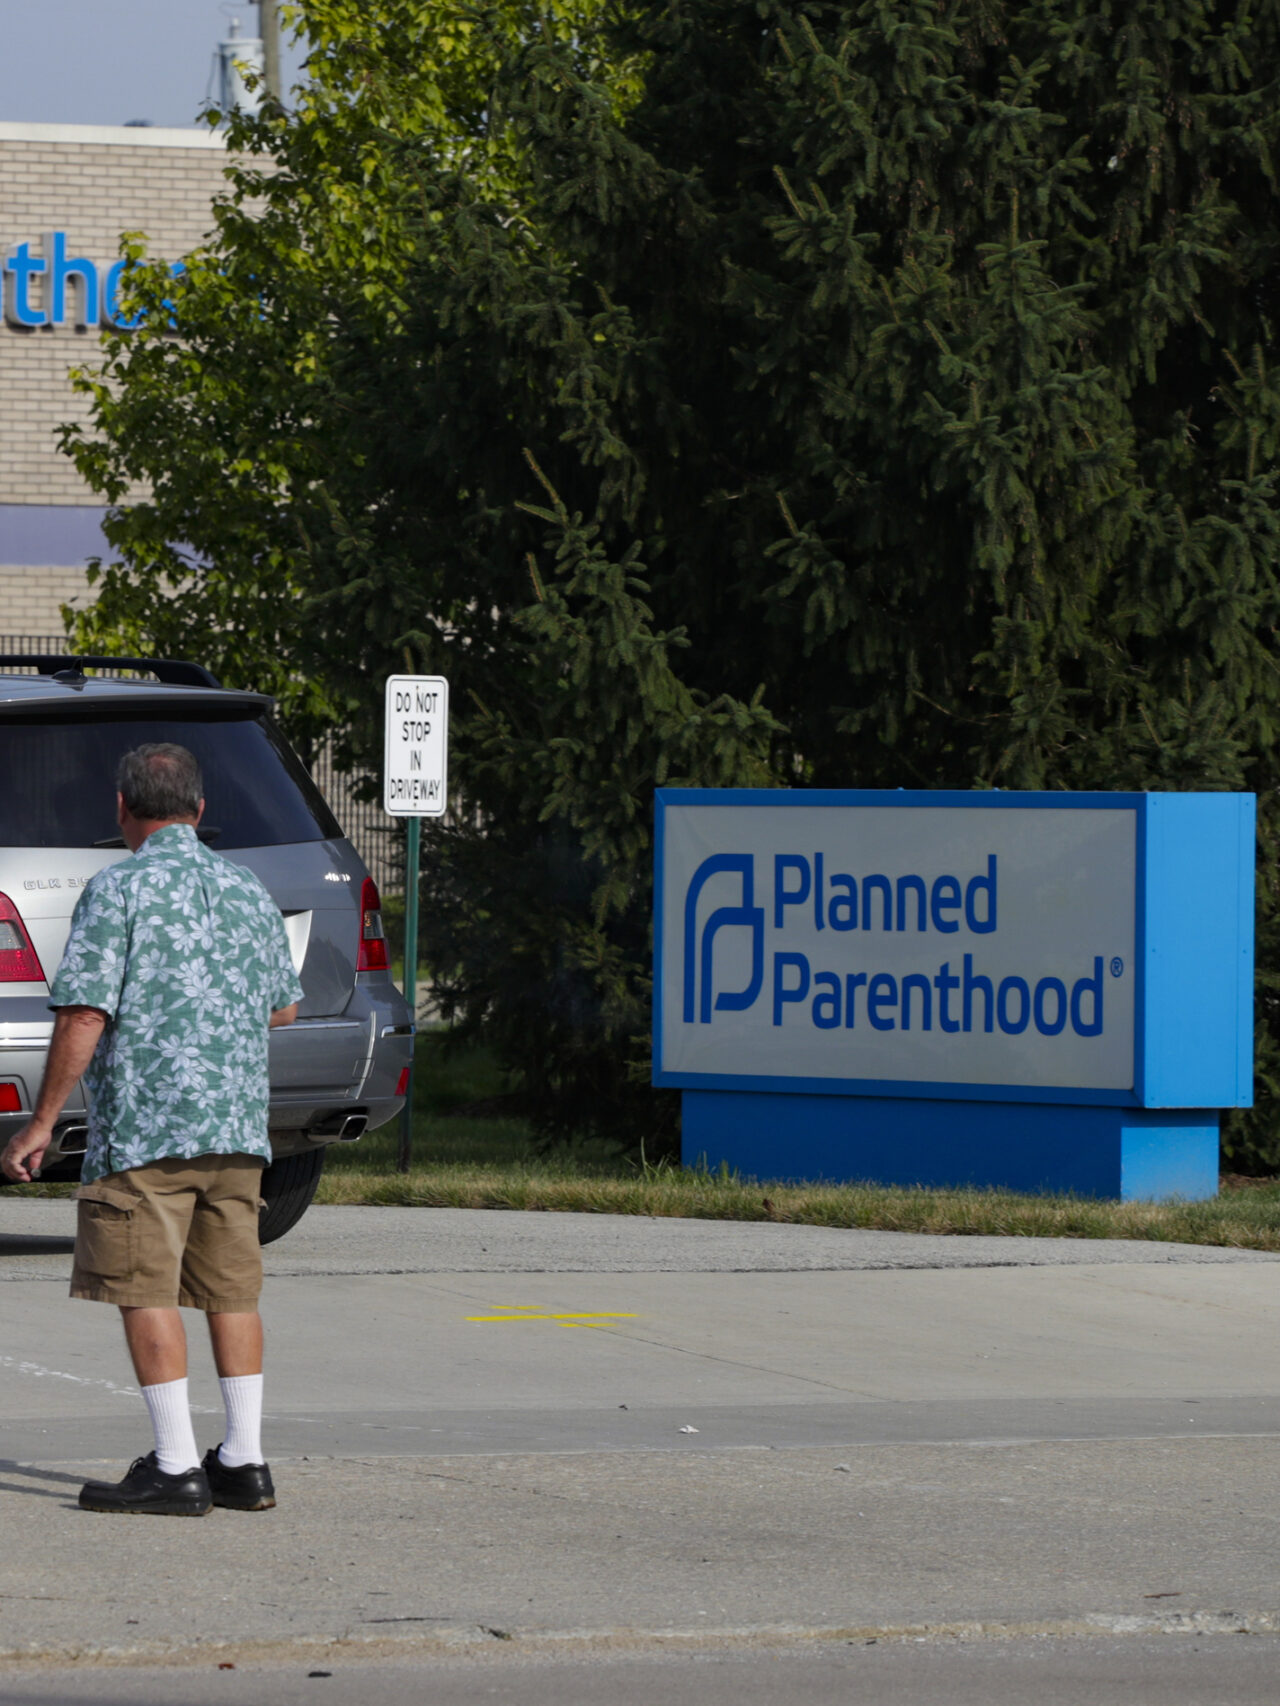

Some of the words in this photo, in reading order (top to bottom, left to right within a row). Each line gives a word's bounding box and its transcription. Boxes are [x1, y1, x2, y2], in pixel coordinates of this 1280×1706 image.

[395, 691, 412, 713] DO
[415, 691, 438, 714] NOT
[401, 720, 432, 743] STOP
[410, 750, 423, 771] IN
[390, 777, 441, 801] DRIVEWAY
[23, 877, 61, 891] GLK
[773, 851, 998, 935] Planned
